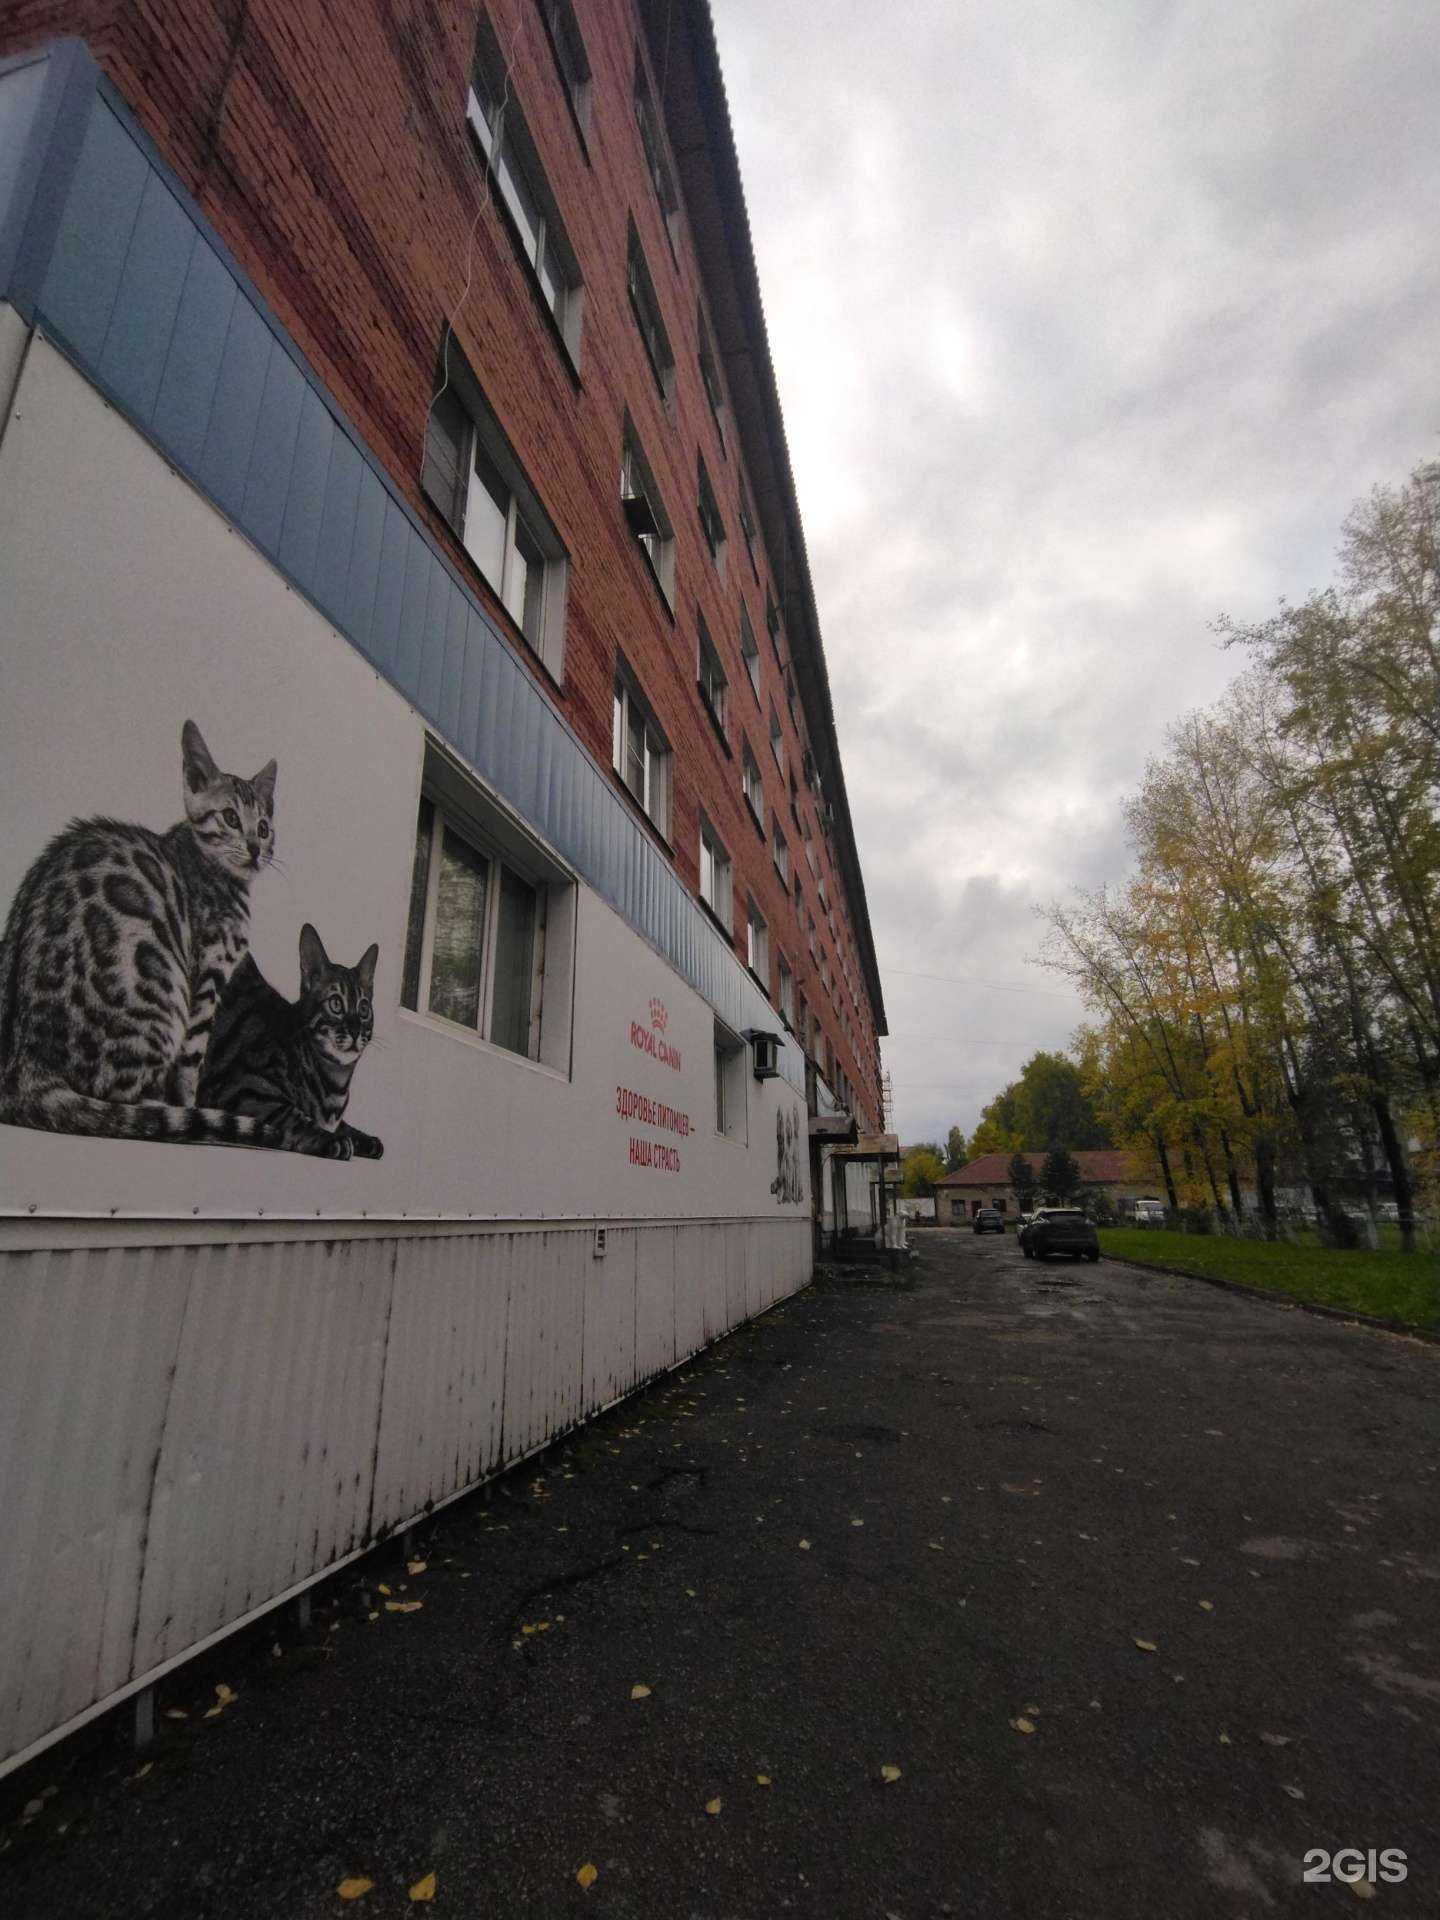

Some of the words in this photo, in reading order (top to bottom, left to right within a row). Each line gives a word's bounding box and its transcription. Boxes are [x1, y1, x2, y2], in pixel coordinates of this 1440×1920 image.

[630, 1021, 657, 1058] ROYAL
[616, 1086, 657, 1125] ЗДОРОВЬЕ
[658, 1103, 689, 1138] ПИТОМЦЕВ
[629, 1136, 652, 1168] НАША
[654, 1143, 681, 1173] СТРАСТЬ
